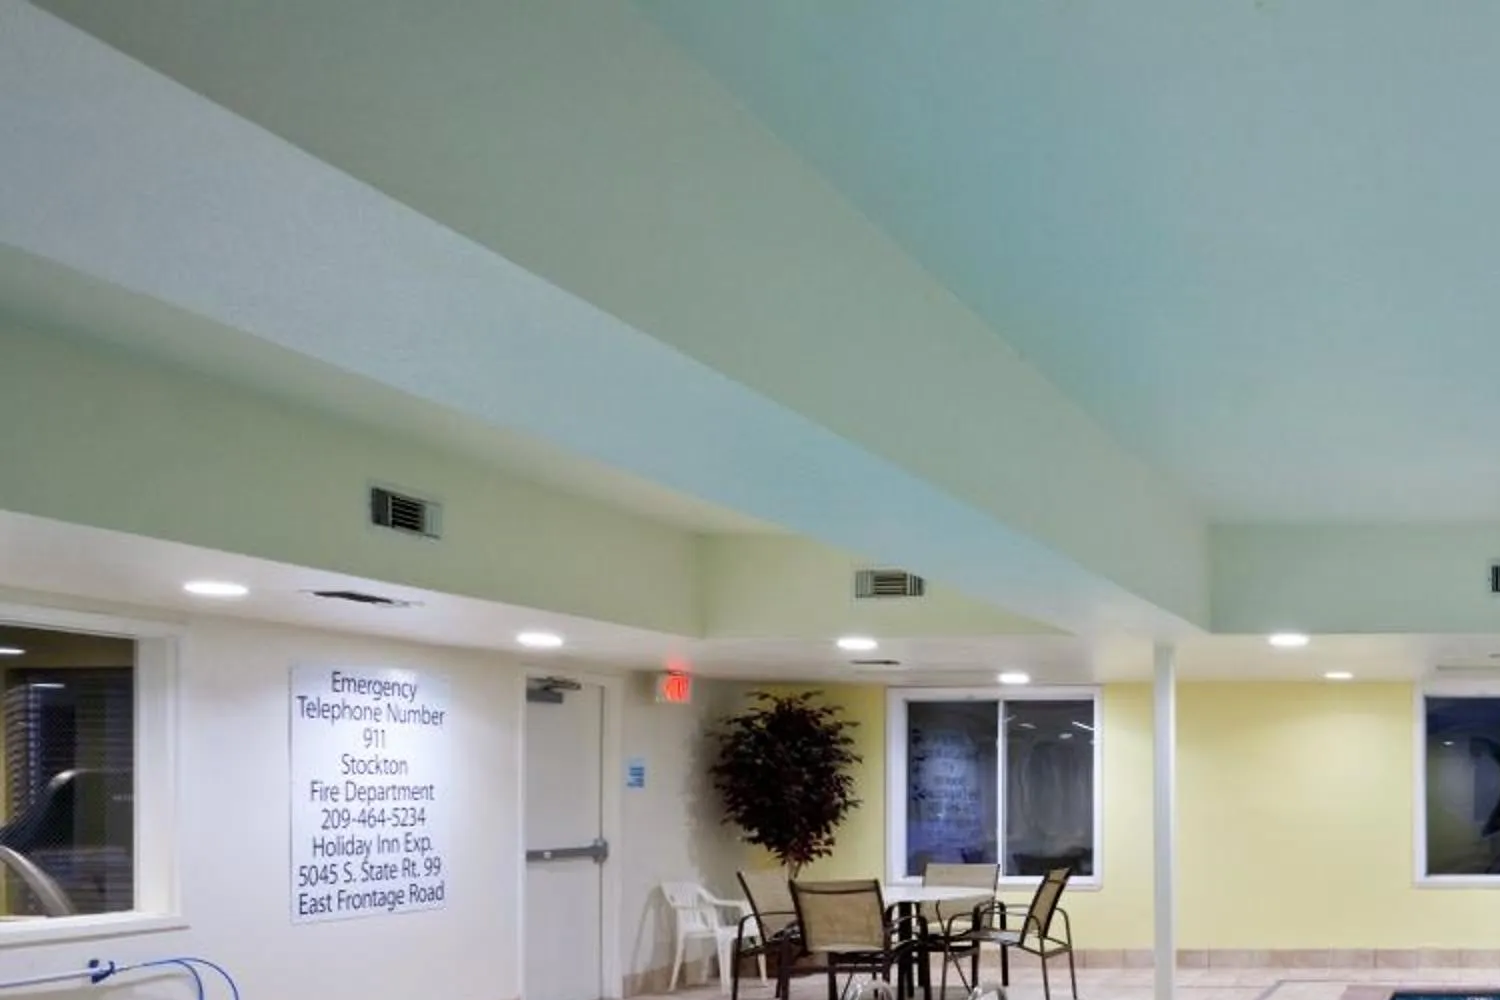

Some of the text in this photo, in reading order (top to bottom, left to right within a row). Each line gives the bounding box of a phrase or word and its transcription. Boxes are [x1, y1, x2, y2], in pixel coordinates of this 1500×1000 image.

[332, 671, 418, 702] Emergency
[297, 695, 445, 726] Telephone Number
[363, 727, 386, 749] 911
[341, 753, 408, 775] Stockton
[310, 780, 435, 805] Fire Department
[321, 807, 426, 830] 209-464-5234
[312, 832, 433, 862] Holiday Inn Exp.
[298, 857, 441, 887] 5045 S. State Rt. 99
[299, 882, 445, 915] East Frontage Road
